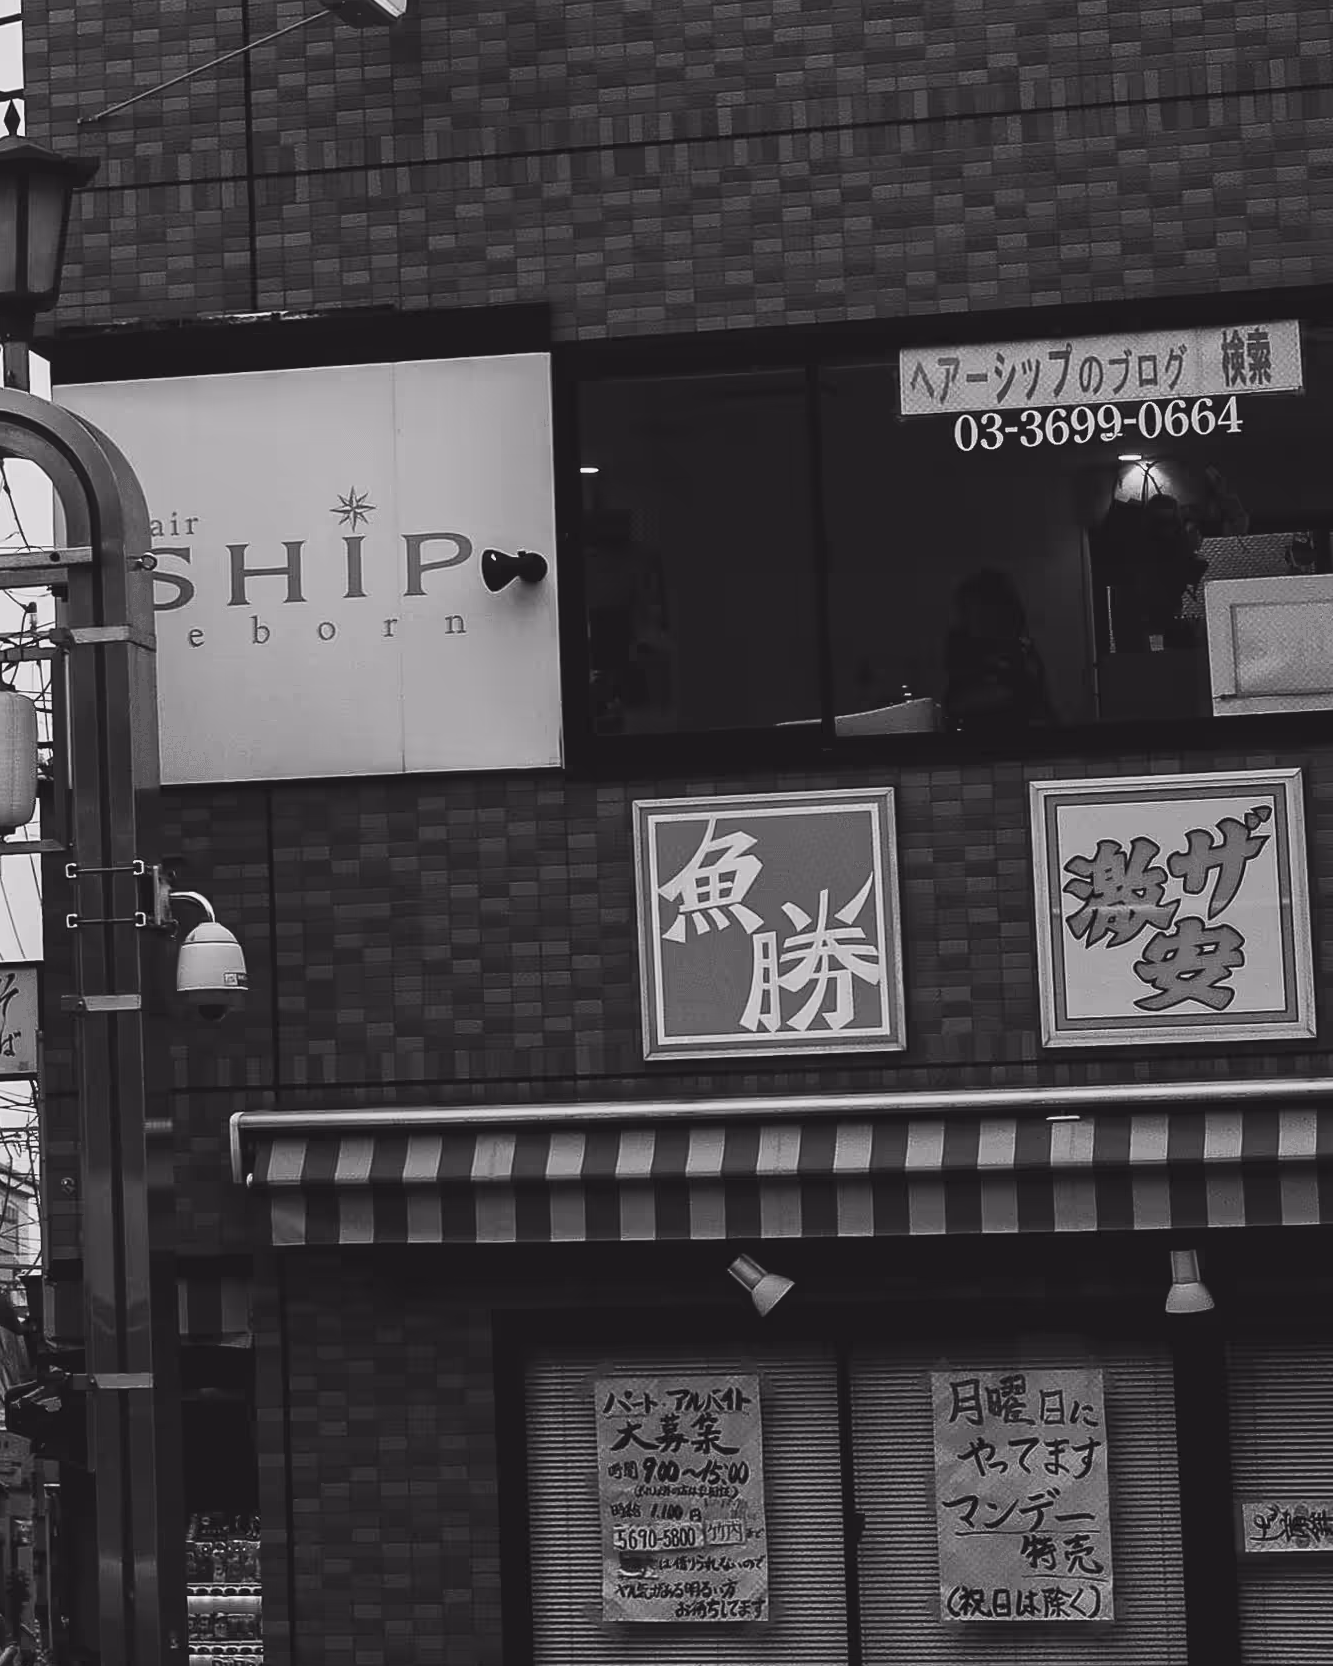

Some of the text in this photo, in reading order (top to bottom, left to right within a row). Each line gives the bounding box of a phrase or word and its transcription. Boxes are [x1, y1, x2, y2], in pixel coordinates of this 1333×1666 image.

[910, 328, 1273, 404] ヘアーシップのブログ 検索
[953, 395, 1244, 452] 03-3699-0664
[150, 510, 199, 537] air
[151, 532, 474, 612] SHIP
[188, 613, 467, 649] eborn
[659, 815, 882, 1034] 魚勝
[949, 1374, 1100, 1427] 月曜日に
[609, 1412, 741, 1455] 大募集
[957, 1436, 1102, 1480] やってます
[941, 1487, 1096, 1531] マンデー
[1019, 1533, 1105, 1574] 特売
[946, 1585, 1102, 1619] (祝日は除く)
